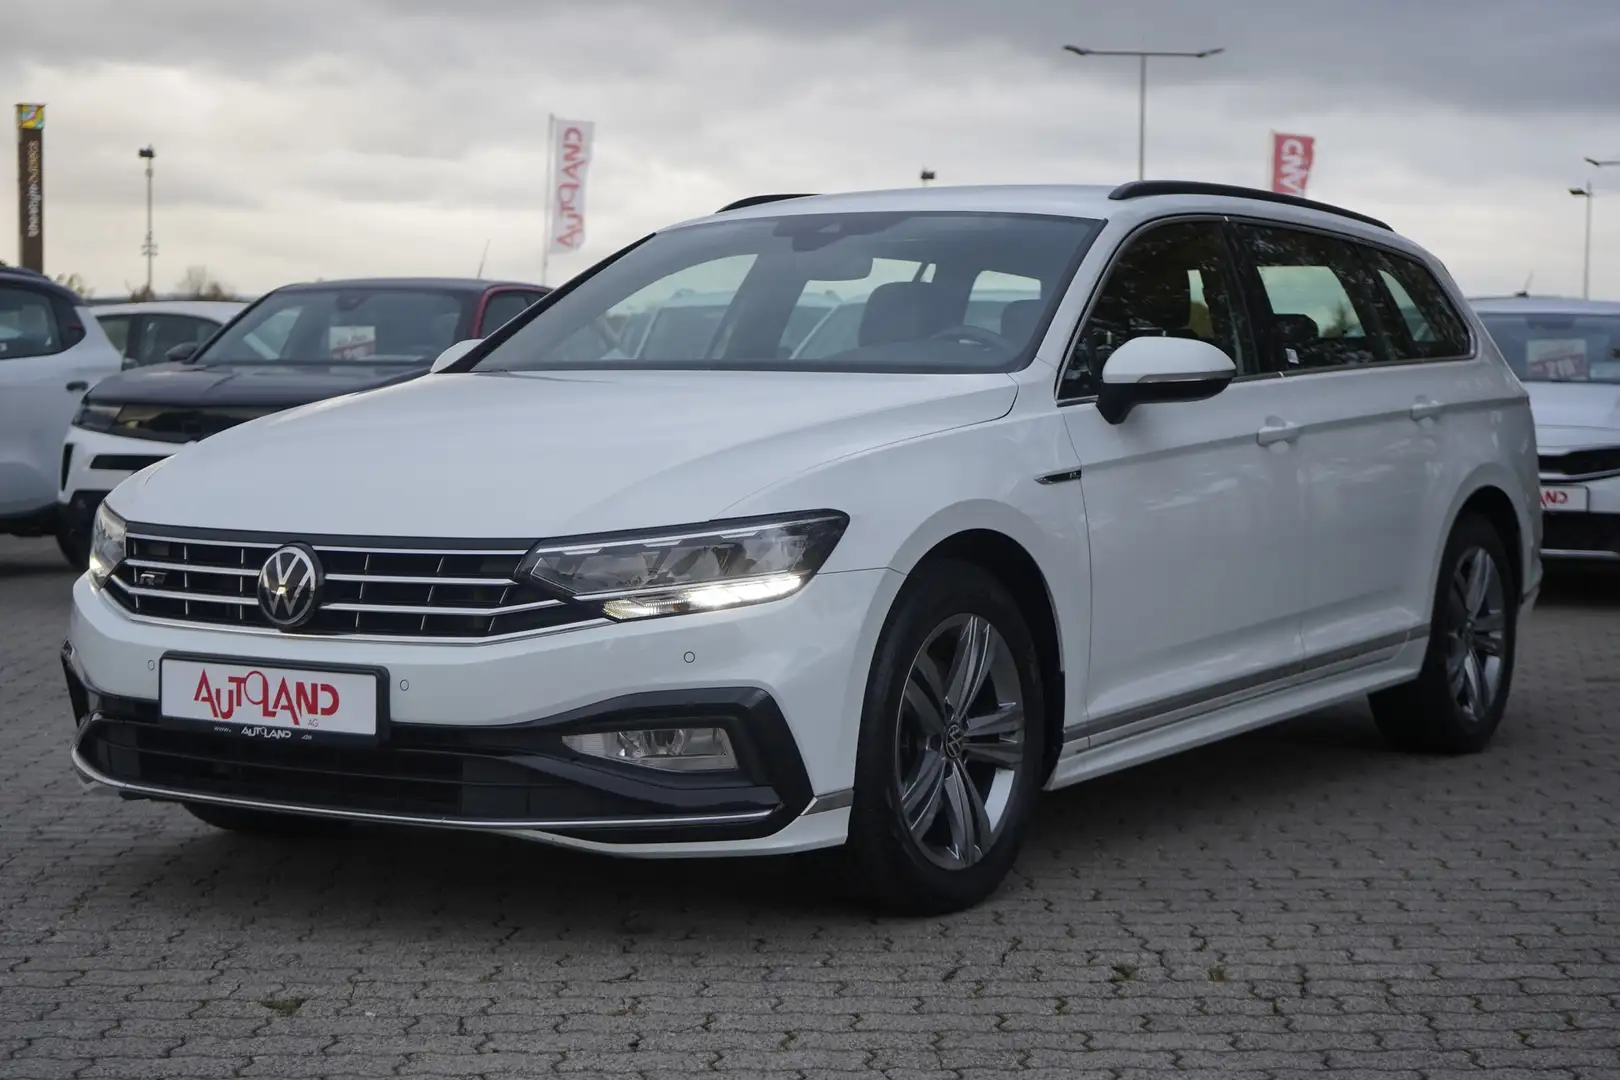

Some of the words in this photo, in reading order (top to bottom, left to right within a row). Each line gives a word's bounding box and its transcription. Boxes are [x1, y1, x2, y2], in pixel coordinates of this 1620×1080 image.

[194, 668, 340, 726] AUTOLAND
[307, 718, 319, 728] AG
[241, 726, 292, 740] AUTOLAND
